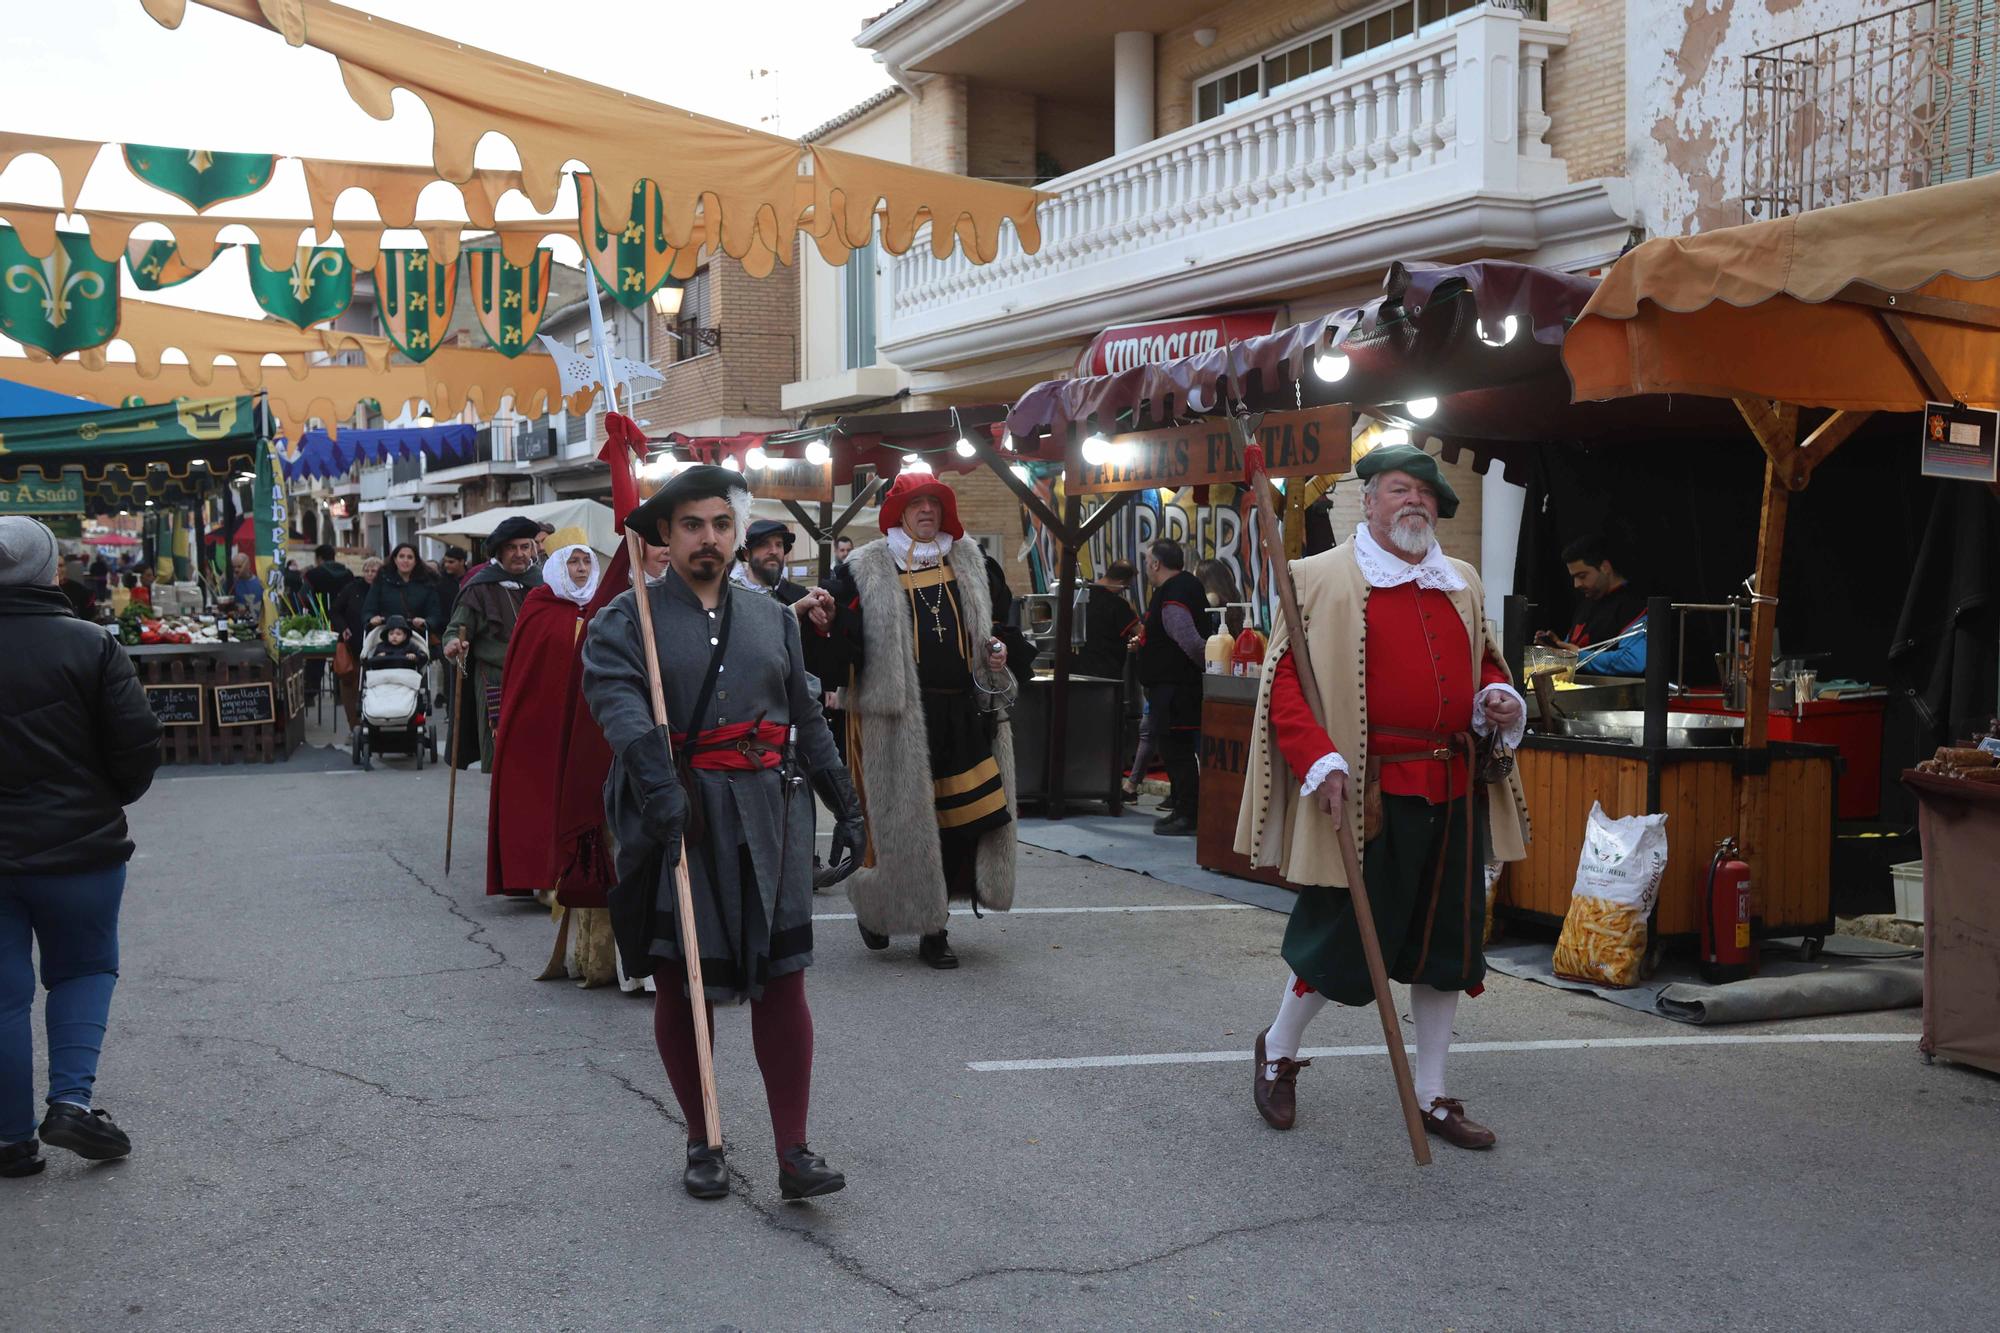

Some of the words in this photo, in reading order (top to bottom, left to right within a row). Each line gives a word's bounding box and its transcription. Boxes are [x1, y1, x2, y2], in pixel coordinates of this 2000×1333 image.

[1206, 421, 1320, 474] FRTAS
[16, 484, 78, 503] Asado
[1202, 735, 1246, 773] PAT
